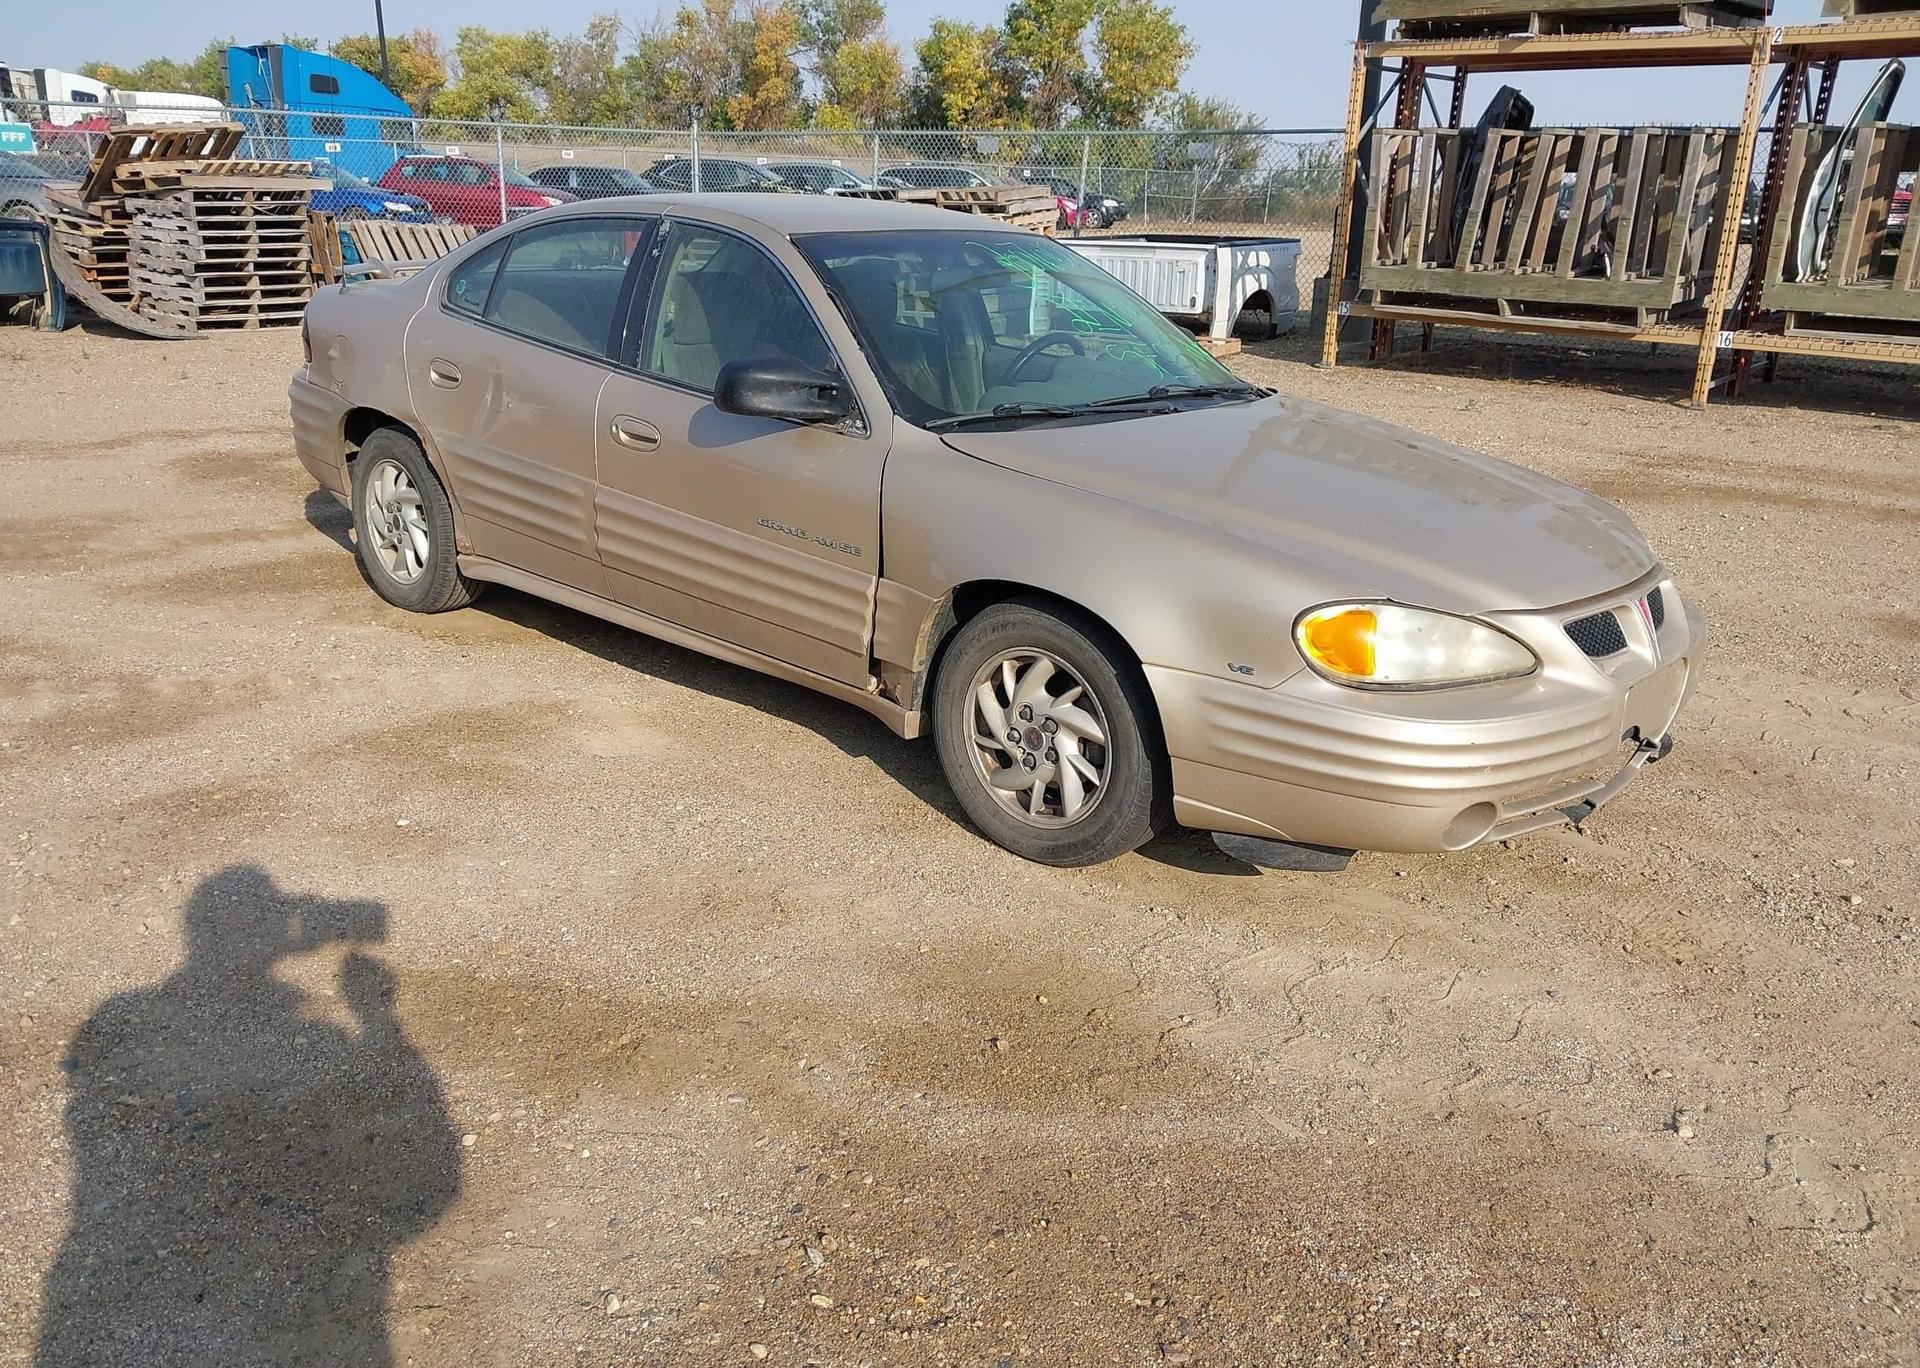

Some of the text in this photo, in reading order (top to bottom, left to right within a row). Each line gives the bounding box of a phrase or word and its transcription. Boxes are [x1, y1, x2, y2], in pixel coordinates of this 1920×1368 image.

[1773, 27, 1783, 44] 2
[1, 131, 26, 142] FFF
[1339, 302, 1350, 315] 15
[1719, 332, 1732, 347] 16
[757, 516, 863, 558] GRAND AM SE
[1227, 663, 1256, 676] V6
